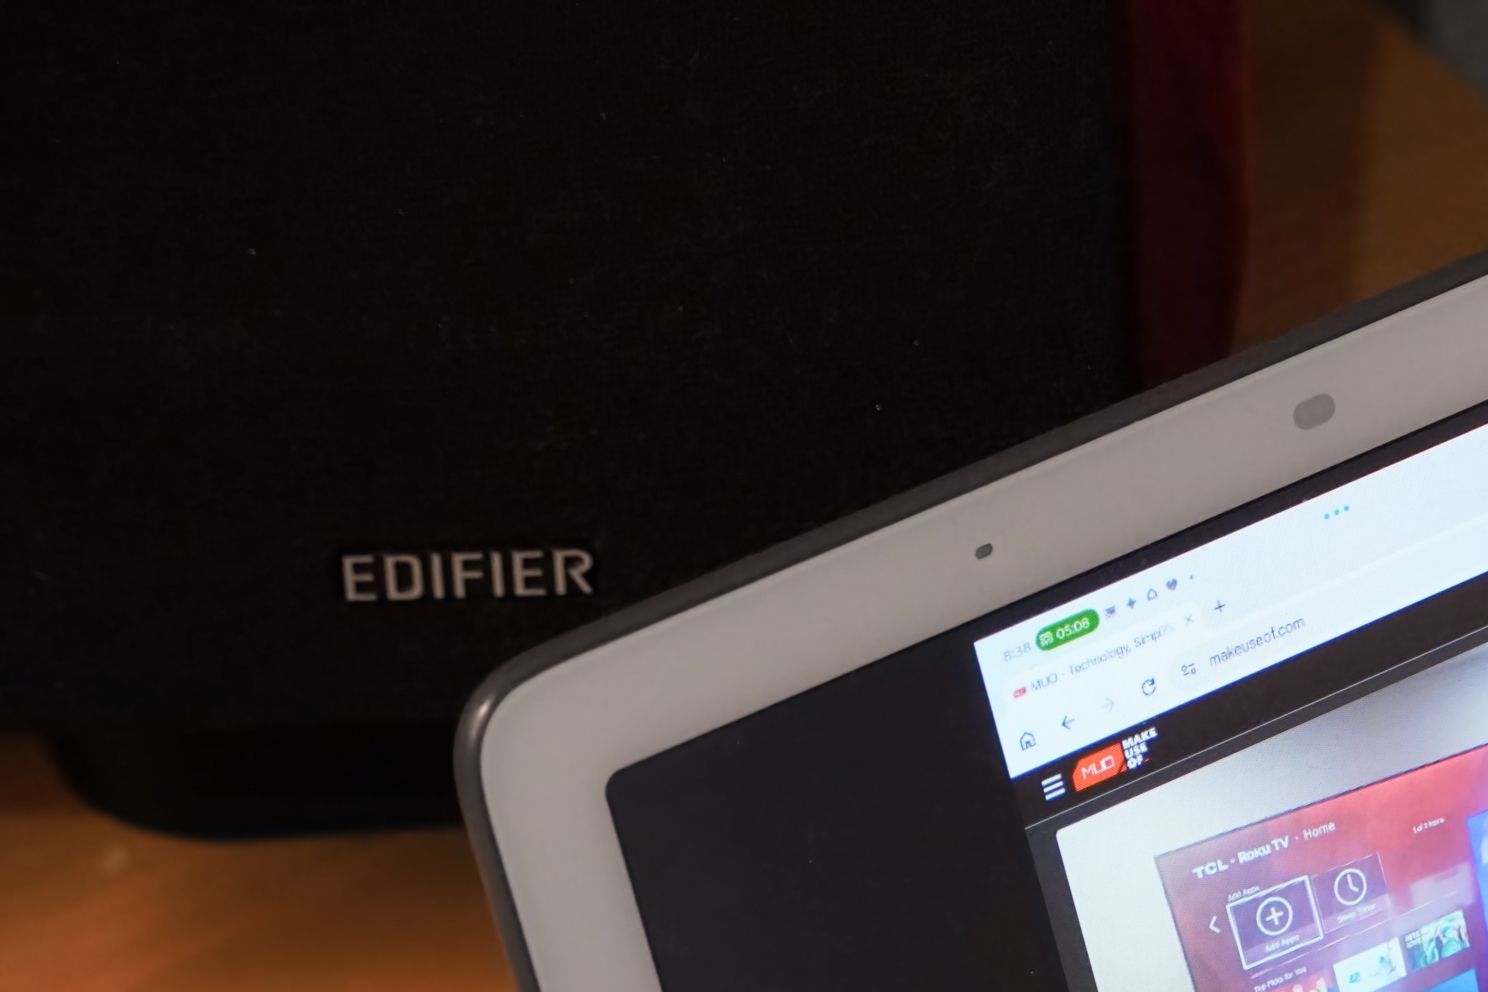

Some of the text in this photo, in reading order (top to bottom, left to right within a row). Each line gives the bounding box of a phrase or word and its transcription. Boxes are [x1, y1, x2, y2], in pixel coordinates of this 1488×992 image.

[341, 548, 594, 602] EDIFIER
[1056, 617, 1090, 640] 05:08
[1208, 618, 1306, 667] makeuseof.com
[1122, 727, 1158, 750] MAKE
[1124, 741, 1148, 760] USE
[1081, 755, 1115, 780] MUO
[1126, 753, 1144, 770] OF
[1192, 821, 1336, 879] TCL Roku TV Home
